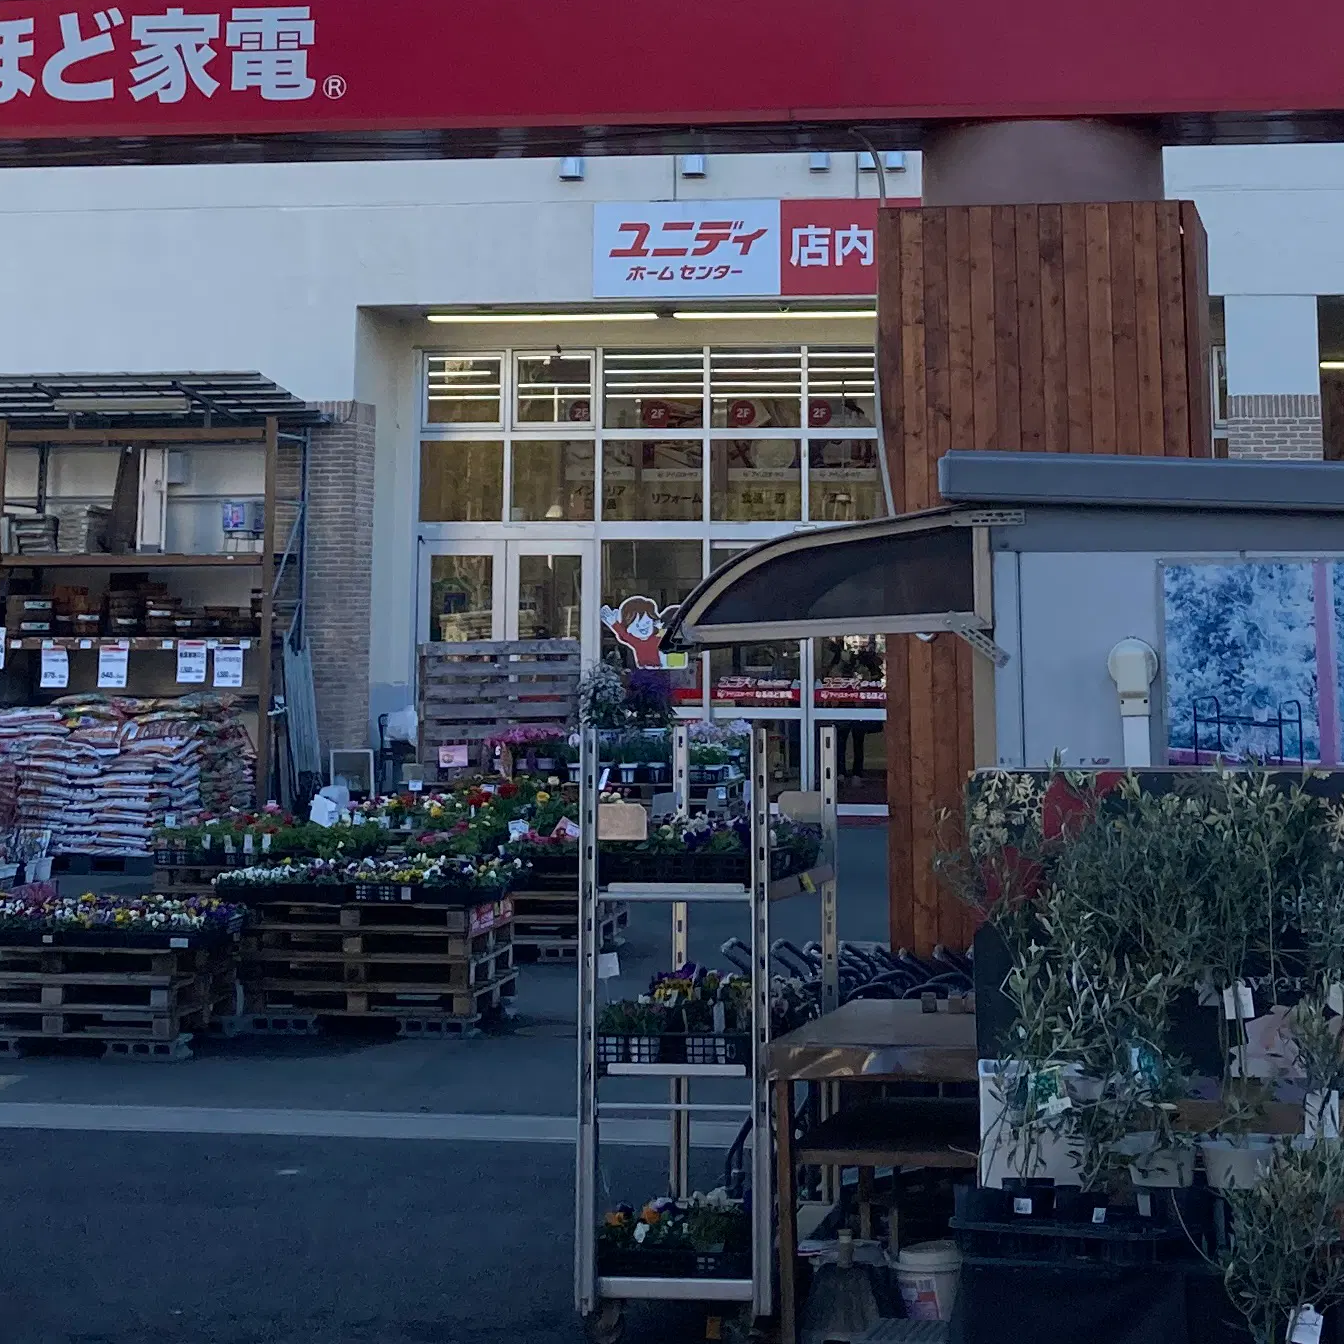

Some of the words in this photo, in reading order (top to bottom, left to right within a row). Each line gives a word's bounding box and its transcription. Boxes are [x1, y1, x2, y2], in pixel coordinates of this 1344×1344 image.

[608, 220, 769, 258] ユニディ
[789, 223, 875, 267] 店内
[650, 407, 666, 419] 2F
[735, 407, 753, 419] 2F
[811, 407, 828, 419] 2F
[651, 492, 703, 504] リフォーム
